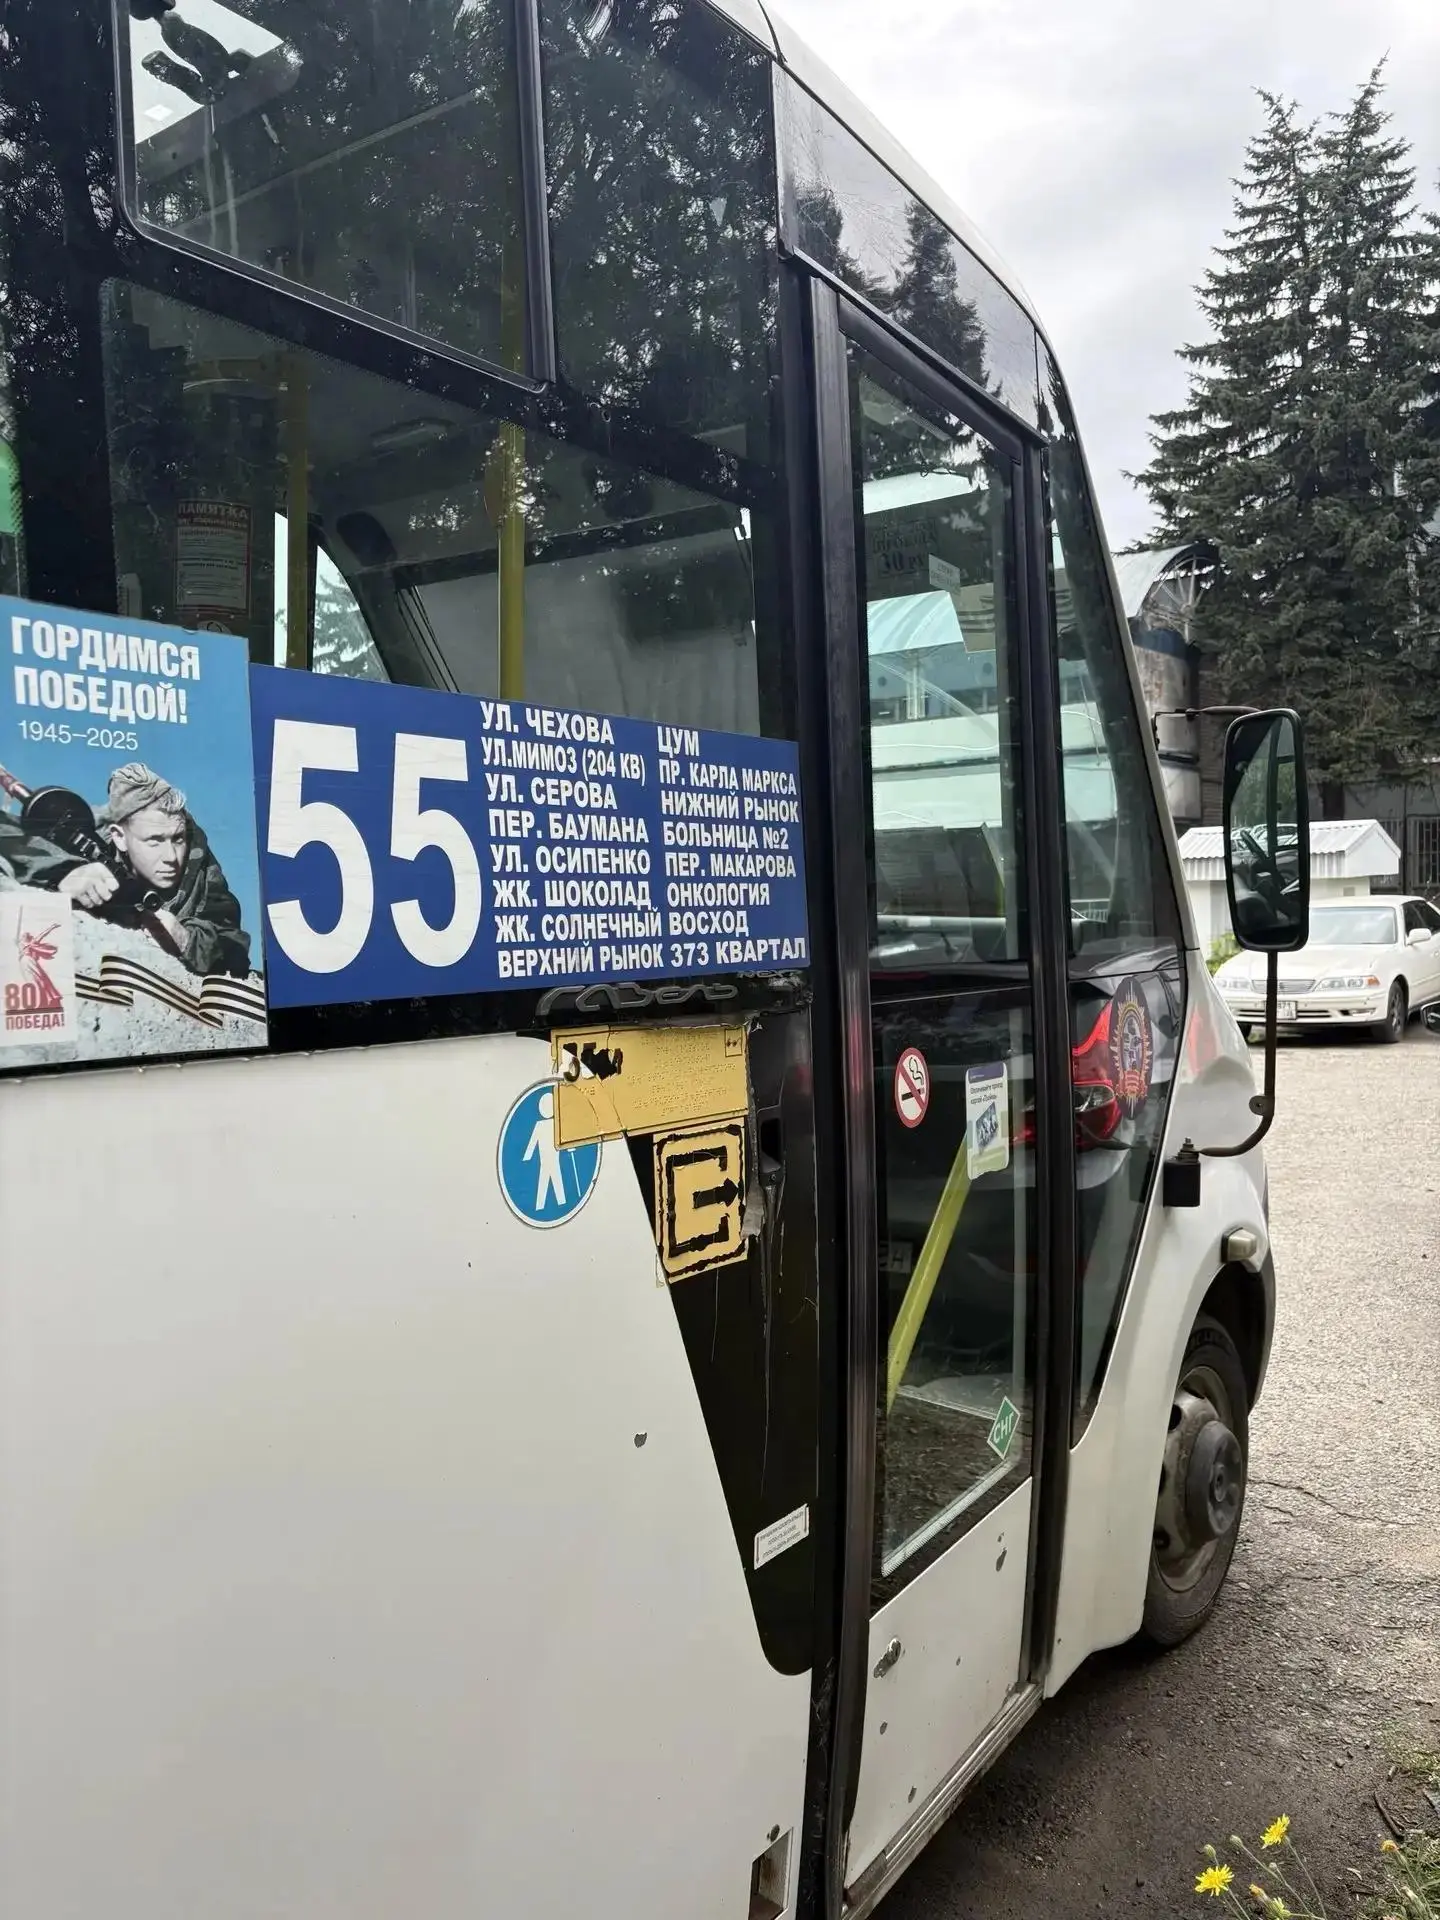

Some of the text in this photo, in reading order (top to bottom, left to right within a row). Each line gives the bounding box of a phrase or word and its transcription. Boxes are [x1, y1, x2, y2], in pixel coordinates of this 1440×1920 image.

[11, 616, 200, 680] ГОРДИМСЯ
[14, 666, 188, 724] ПОБЕДОЙ!
[480, 701, 614, 744] УЛ. ЧЕХОВА
[657, 726, 699, 758] ЦУМ
[485, 773, 617, 809] УЛ. СЕРОВА
[659, 759, 796, 795] ПР. КАРЛА МАРКСА
[661, 790, 799, 822] НИЖНИЙ РЫНОК
[489, 809, 649, 842] ПЕР. БАУМАНА
[663, 821, 788, 852] БОЛЬНИЦА №2
[267, 719, 481, 973] 55
[490, 844, 650, 874] УЛ. ОСИПЕНКО
[665, 852, 796, 877] ПЕР. МАКАРОВА
[493, 880, 651, 910] ЖК. ШОКОЛАД
[667, 883, 769, 907] ОНКОЛОГИЯ
[495, 907, 661, 943] ЖК. СОЛНЕЧНЫЙ
[669, 911, 749, 937] ВОСХОД
[498, 941, 663, 978] ВЕРХНИЙ РЫНОК
[671, 938, 805, 967] 373 КВАРТАЛ
[5, 983, 37, 1009] 80
[6, 1014, 65, 1030] ПОБЕДА!
